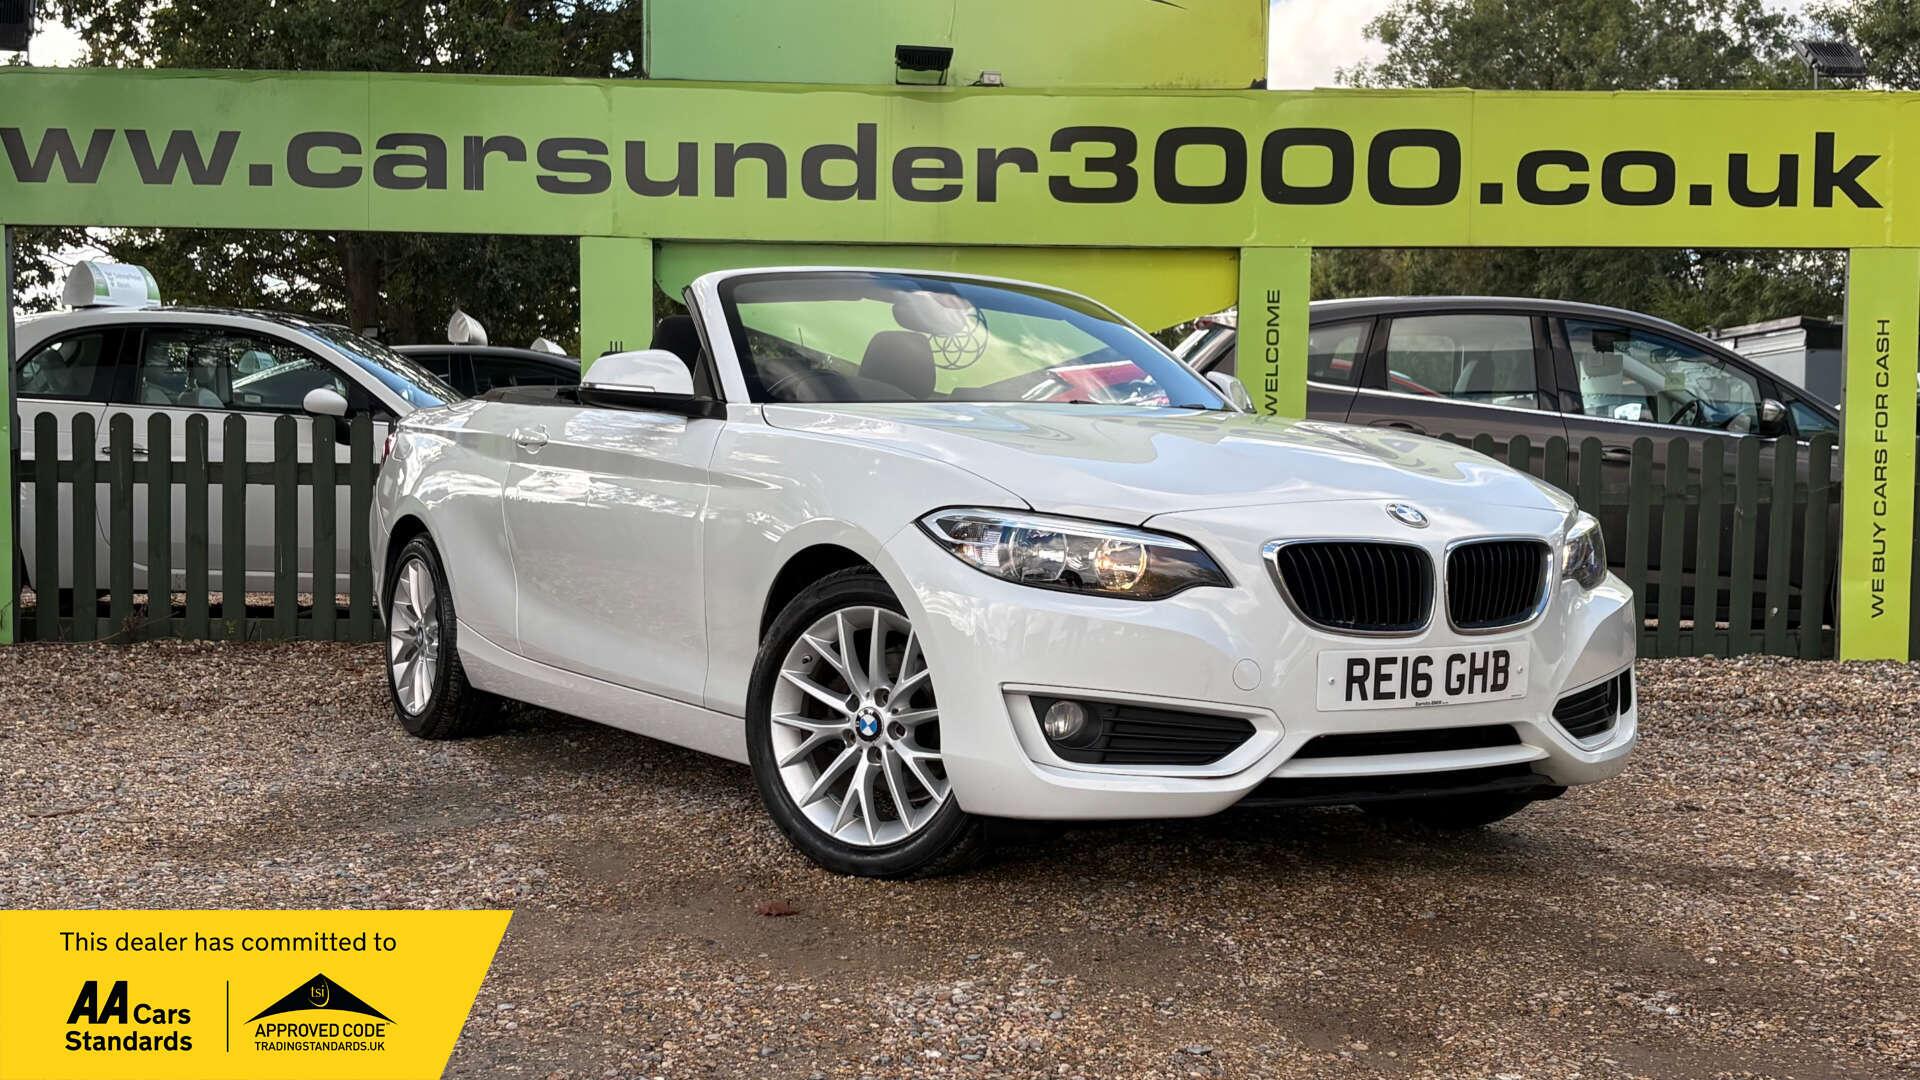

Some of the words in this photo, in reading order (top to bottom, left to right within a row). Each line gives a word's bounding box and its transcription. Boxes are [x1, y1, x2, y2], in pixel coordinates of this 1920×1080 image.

[0, 123, 1883, 208] ww.carsunder3000.co.uk
[1265, 290, 1280, 416] WELCOME
[1876, 320, 1889, 387] CASH
[1875, 395, 1888, 442] FOR
[1874, 449, 1887, 516] CARS
[1873, 523, 1886, 572] BUY
[1872, 579, 1884, 618] WE
[1345, 655, 1434, 702] RE16
[1445, 650, 1510, 696] GHB
